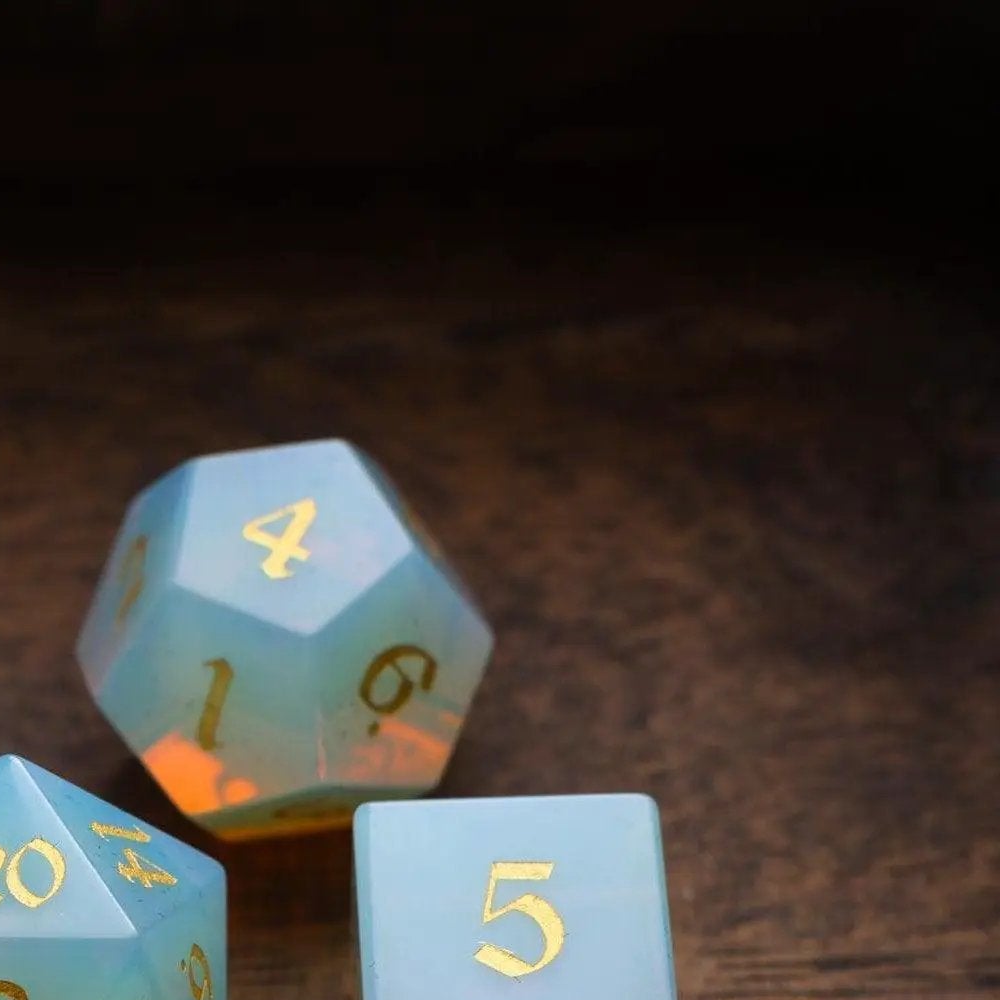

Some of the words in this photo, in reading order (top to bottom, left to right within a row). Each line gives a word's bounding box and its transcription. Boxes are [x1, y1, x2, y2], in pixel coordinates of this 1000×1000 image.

[242, 497, 318, 580] 4
[193, 657, 234, 751] 1
[472, 861, 566, 979] 5
